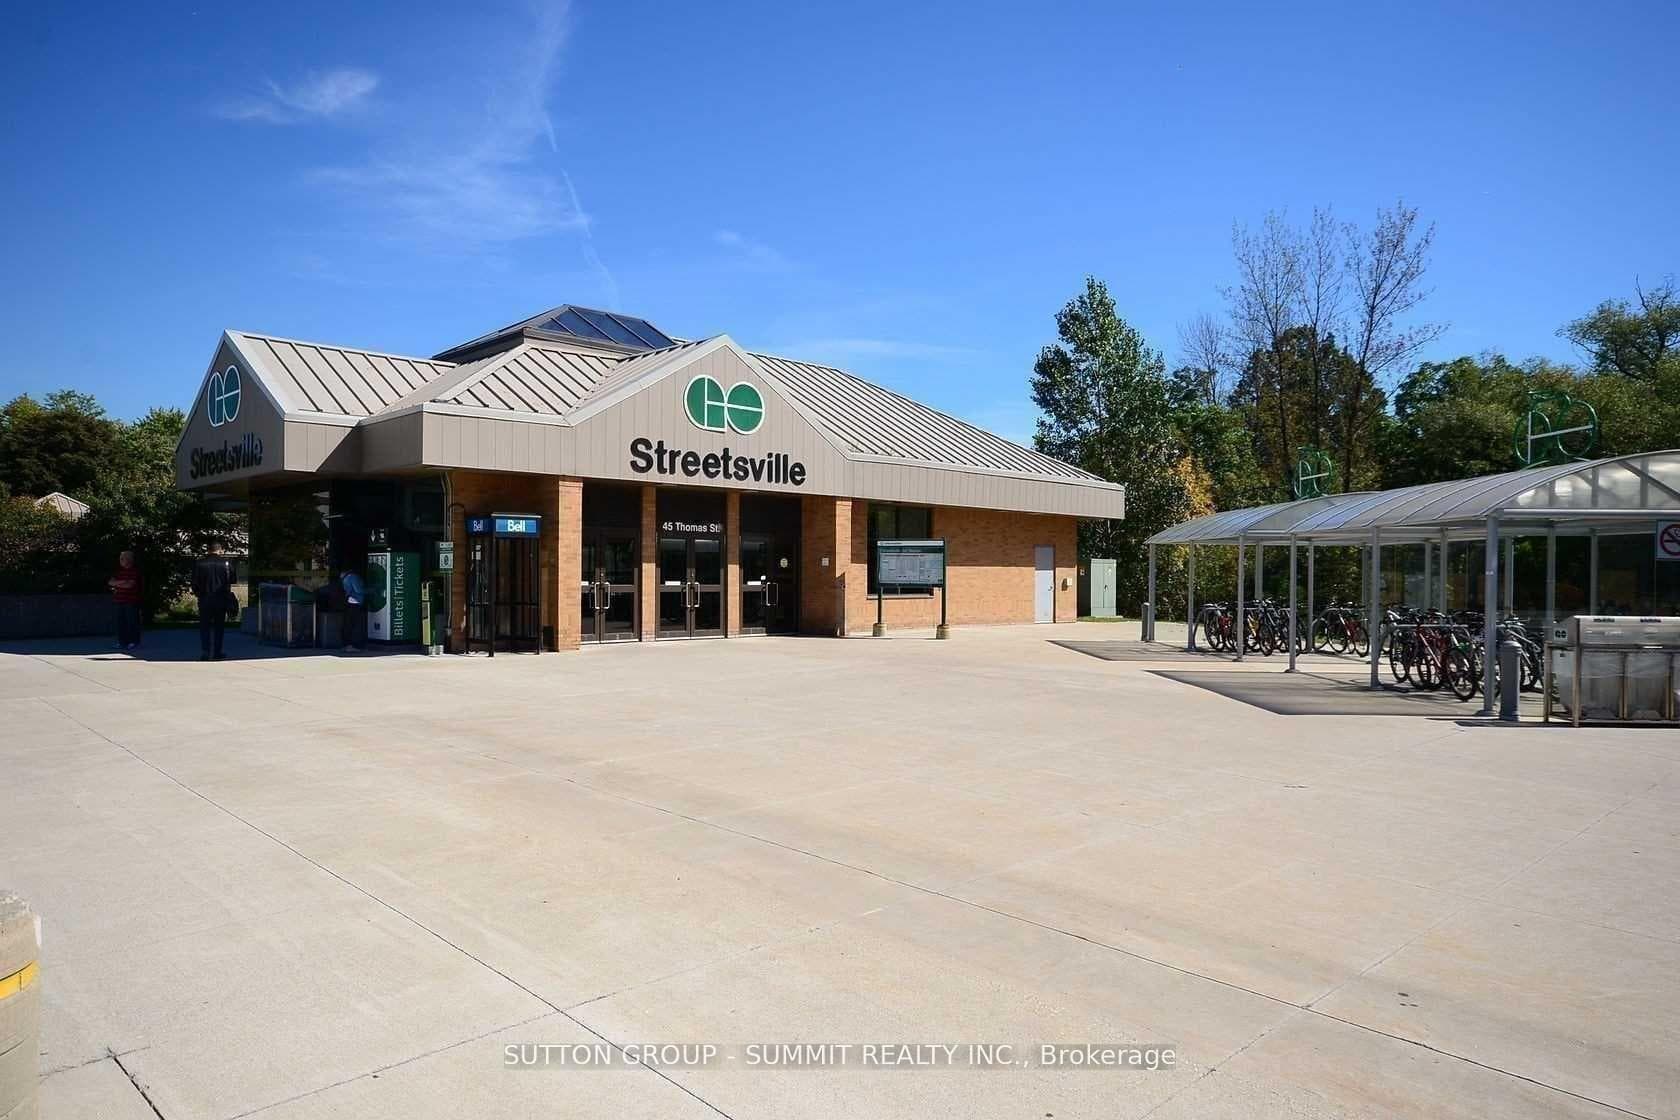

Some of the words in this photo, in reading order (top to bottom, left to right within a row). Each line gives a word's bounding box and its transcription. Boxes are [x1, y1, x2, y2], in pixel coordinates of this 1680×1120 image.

[190, 432, 263, 479] Streetsville
[629, 437, 808, 486] Streetsville
[507, 519, 526, 532] Bell
[662, 522, 673, 531] 45
[675, 522, 708, 532] Thomas
[394, 556, 404, 596] Tickets
[394, 600, 404, 636] Billets
